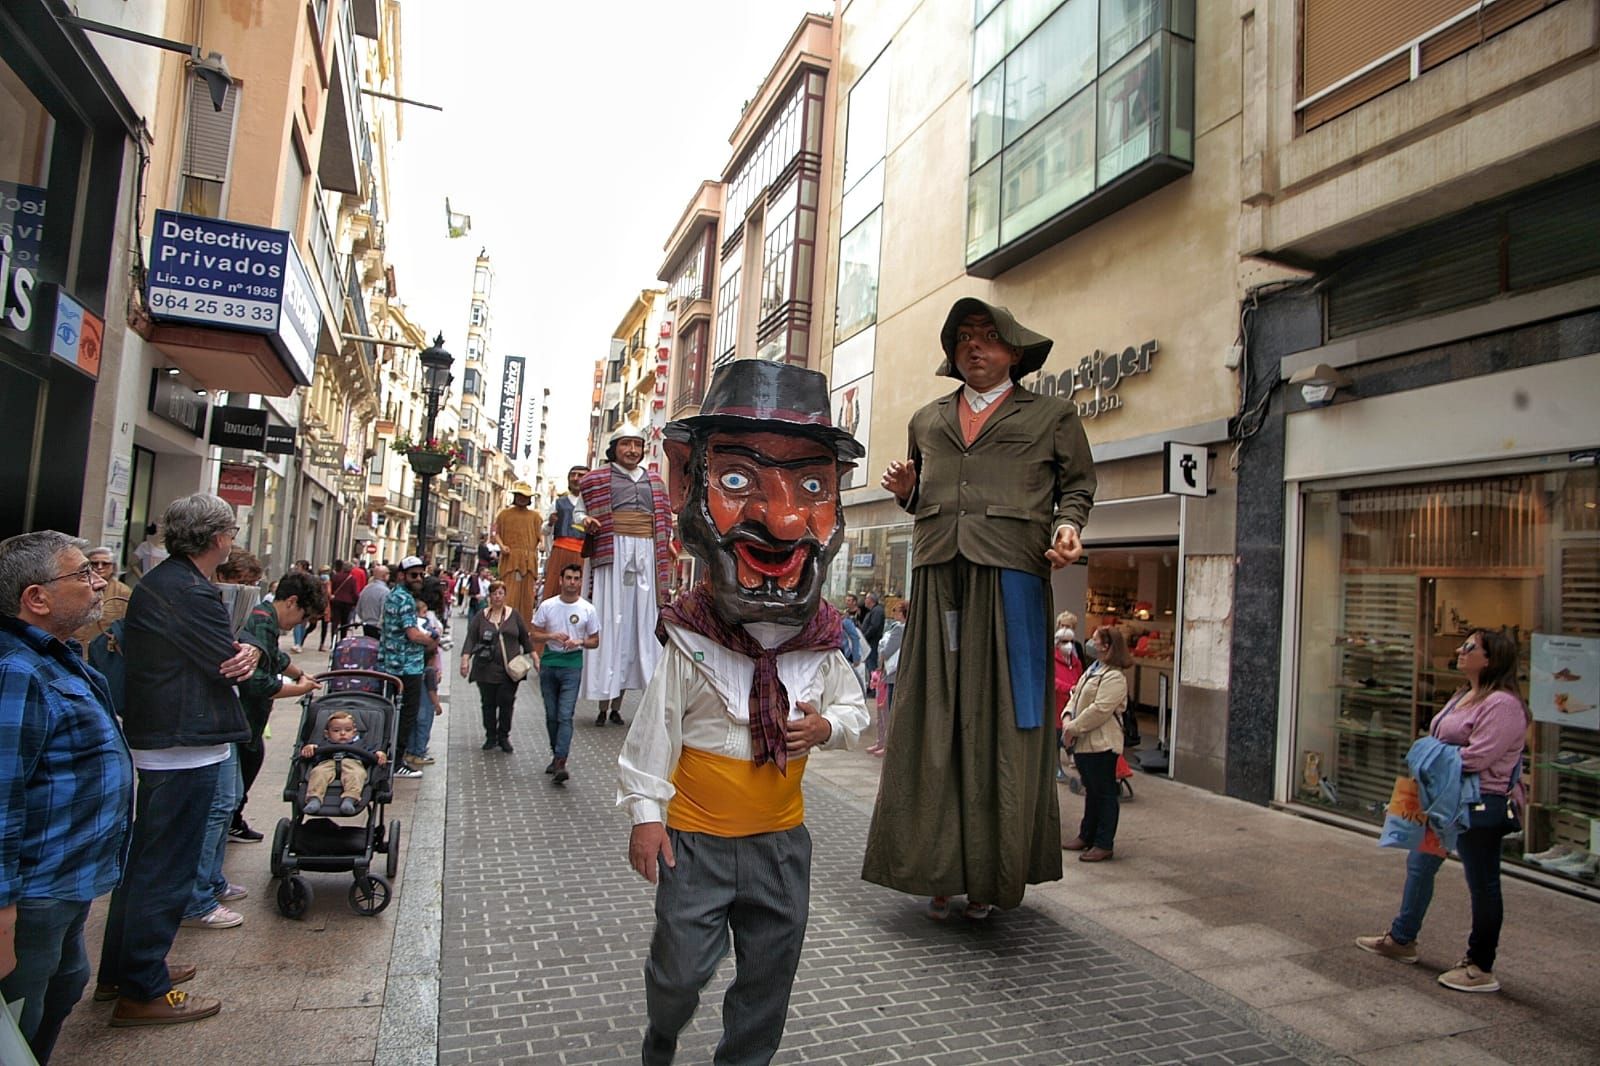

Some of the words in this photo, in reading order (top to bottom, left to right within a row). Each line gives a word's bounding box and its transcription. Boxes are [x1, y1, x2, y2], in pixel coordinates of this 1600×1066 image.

[162, 221, 283, 255] Detectives
[161, 245, 280, 278] Privados
[156, 272, 181, 285] Lic.
[245, 285, 277, 298] 1935
[152, 293, 189, 310] 964
[194, 299, 218, 314] 25
[223, 303, 246, 318] 33
[251, 307, 273, 321] 33
[502, 397, 515, 408] la
[500, 409, 514, 454] muebles
